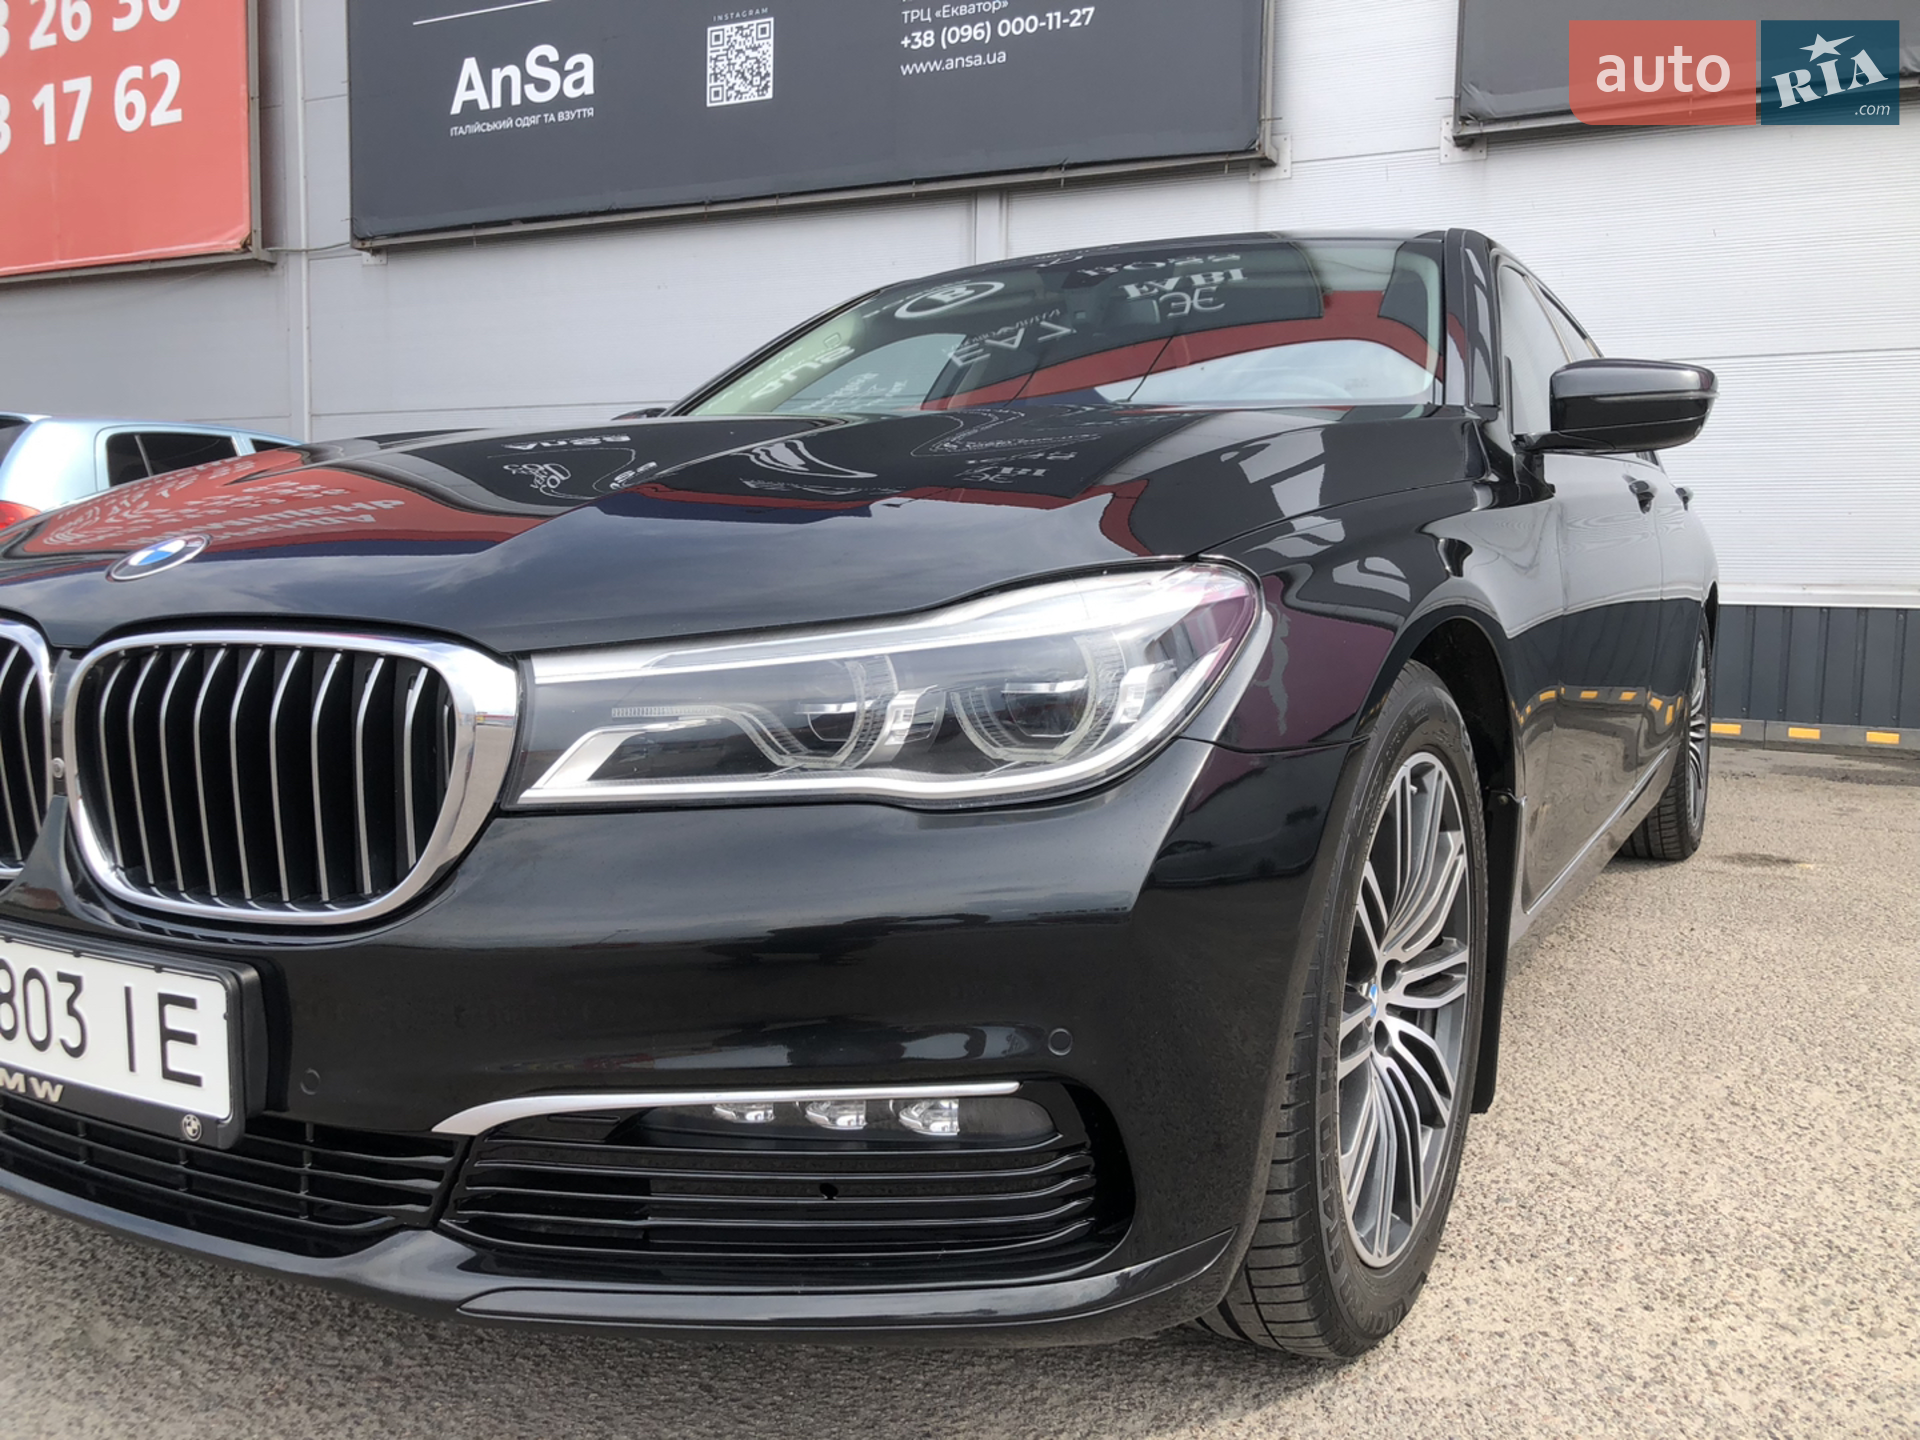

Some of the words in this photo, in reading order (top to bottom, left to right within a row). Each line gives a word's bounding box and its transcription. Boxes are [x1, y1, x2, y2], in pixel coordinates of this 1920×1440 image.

[712, 7, 769, 22] INSTAGRAM
[900, 30, 935, 50] +38
[940, 20, 991, 50] (096)
[997, 6, 1096, 38] 000-11-27
[902, 7, 932, 24] ТРЦ
[899, 51, 1007, 77] www.ansa.ua
[450, 44, 595, 115] AnSa
[32, 75, 93, 146] 17
[114, 58, 183, 133] 62
[450, 117, 513, 137] ІТАЛІЙСЬКИЙ
[514, 114, 541, 128] ОДЯГ
[543, 112, 556, 124] ТА
[557, 107, 594, 122] ВЗУТТЯ
